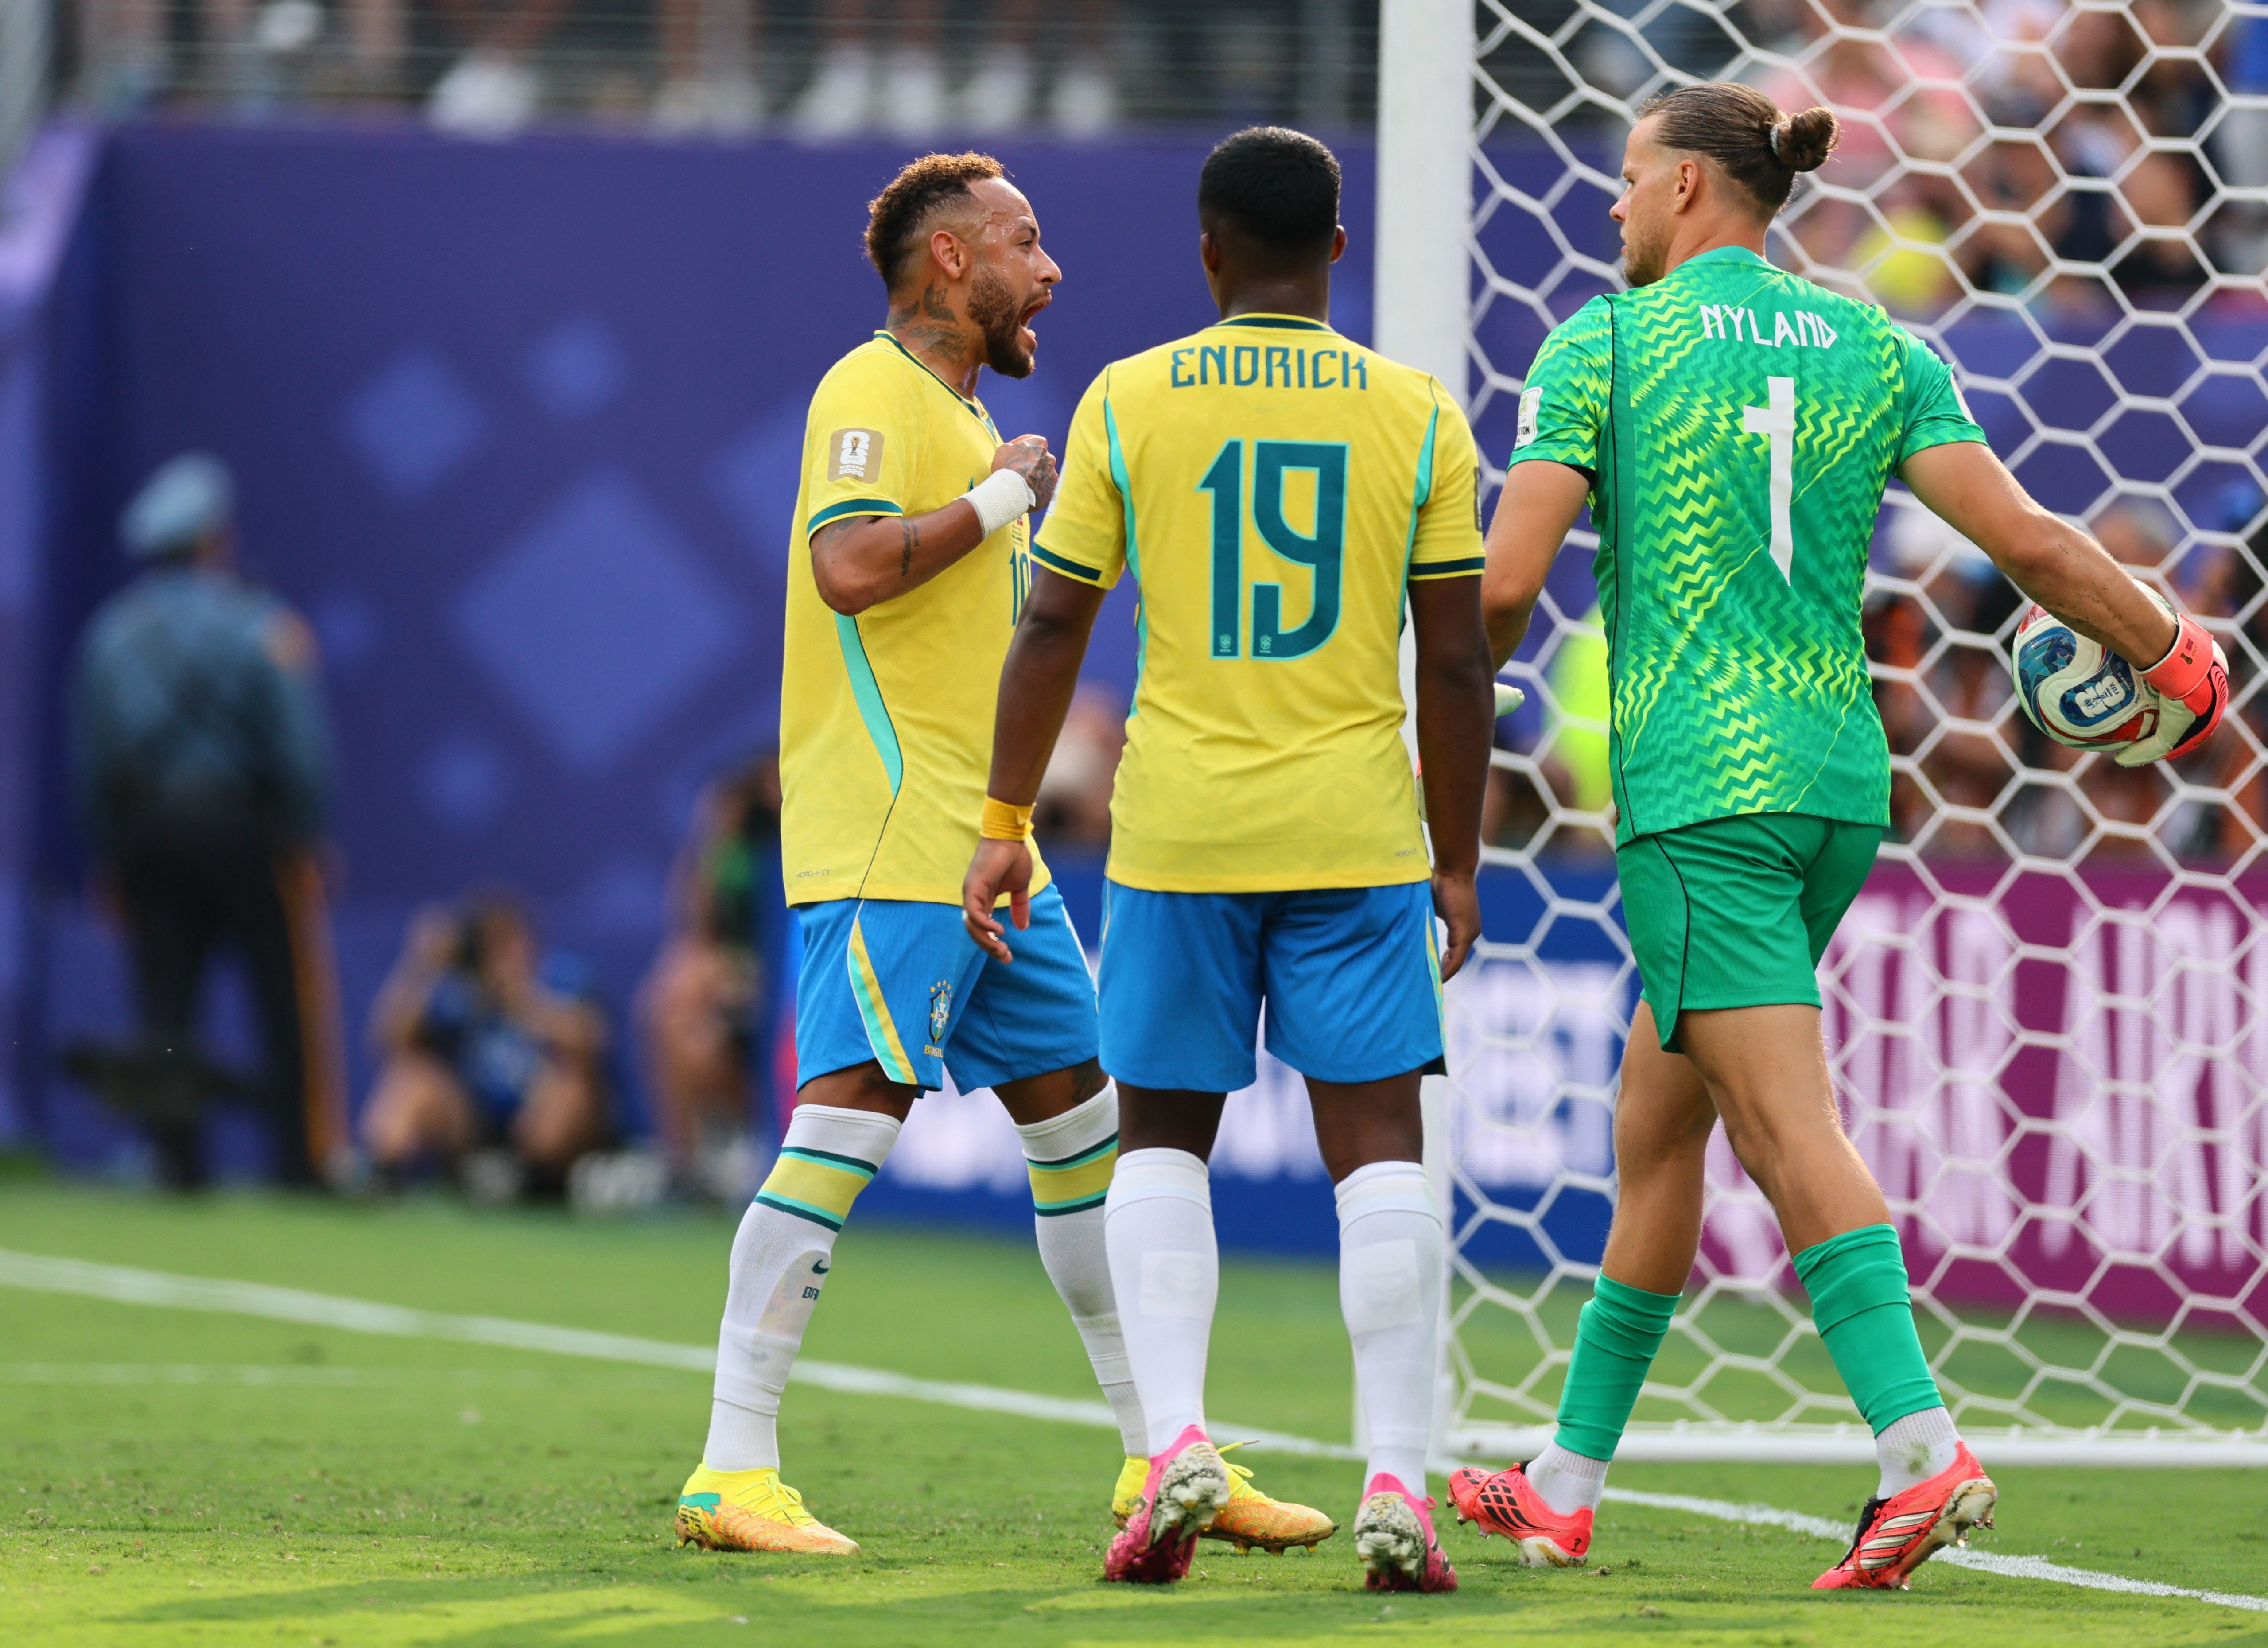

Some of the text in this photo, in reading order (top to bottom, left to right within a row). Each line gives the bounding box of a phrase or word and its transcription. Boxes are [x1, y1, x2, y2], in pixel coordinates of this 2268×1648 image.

[1699, 304, 1837, 349] NYLAND
[1171, 346, 1367, 390] ENDRICK
[839, 468, 864, 478] 2026
[1743, 376, 1794, 586] 1
[1194, 437, 1351, 661] 19
[1009, 546, 1031, 626] 10
[2109, 682, 2120, 695] FIFA
[796, 869, 831, 878] AERO-FIT
